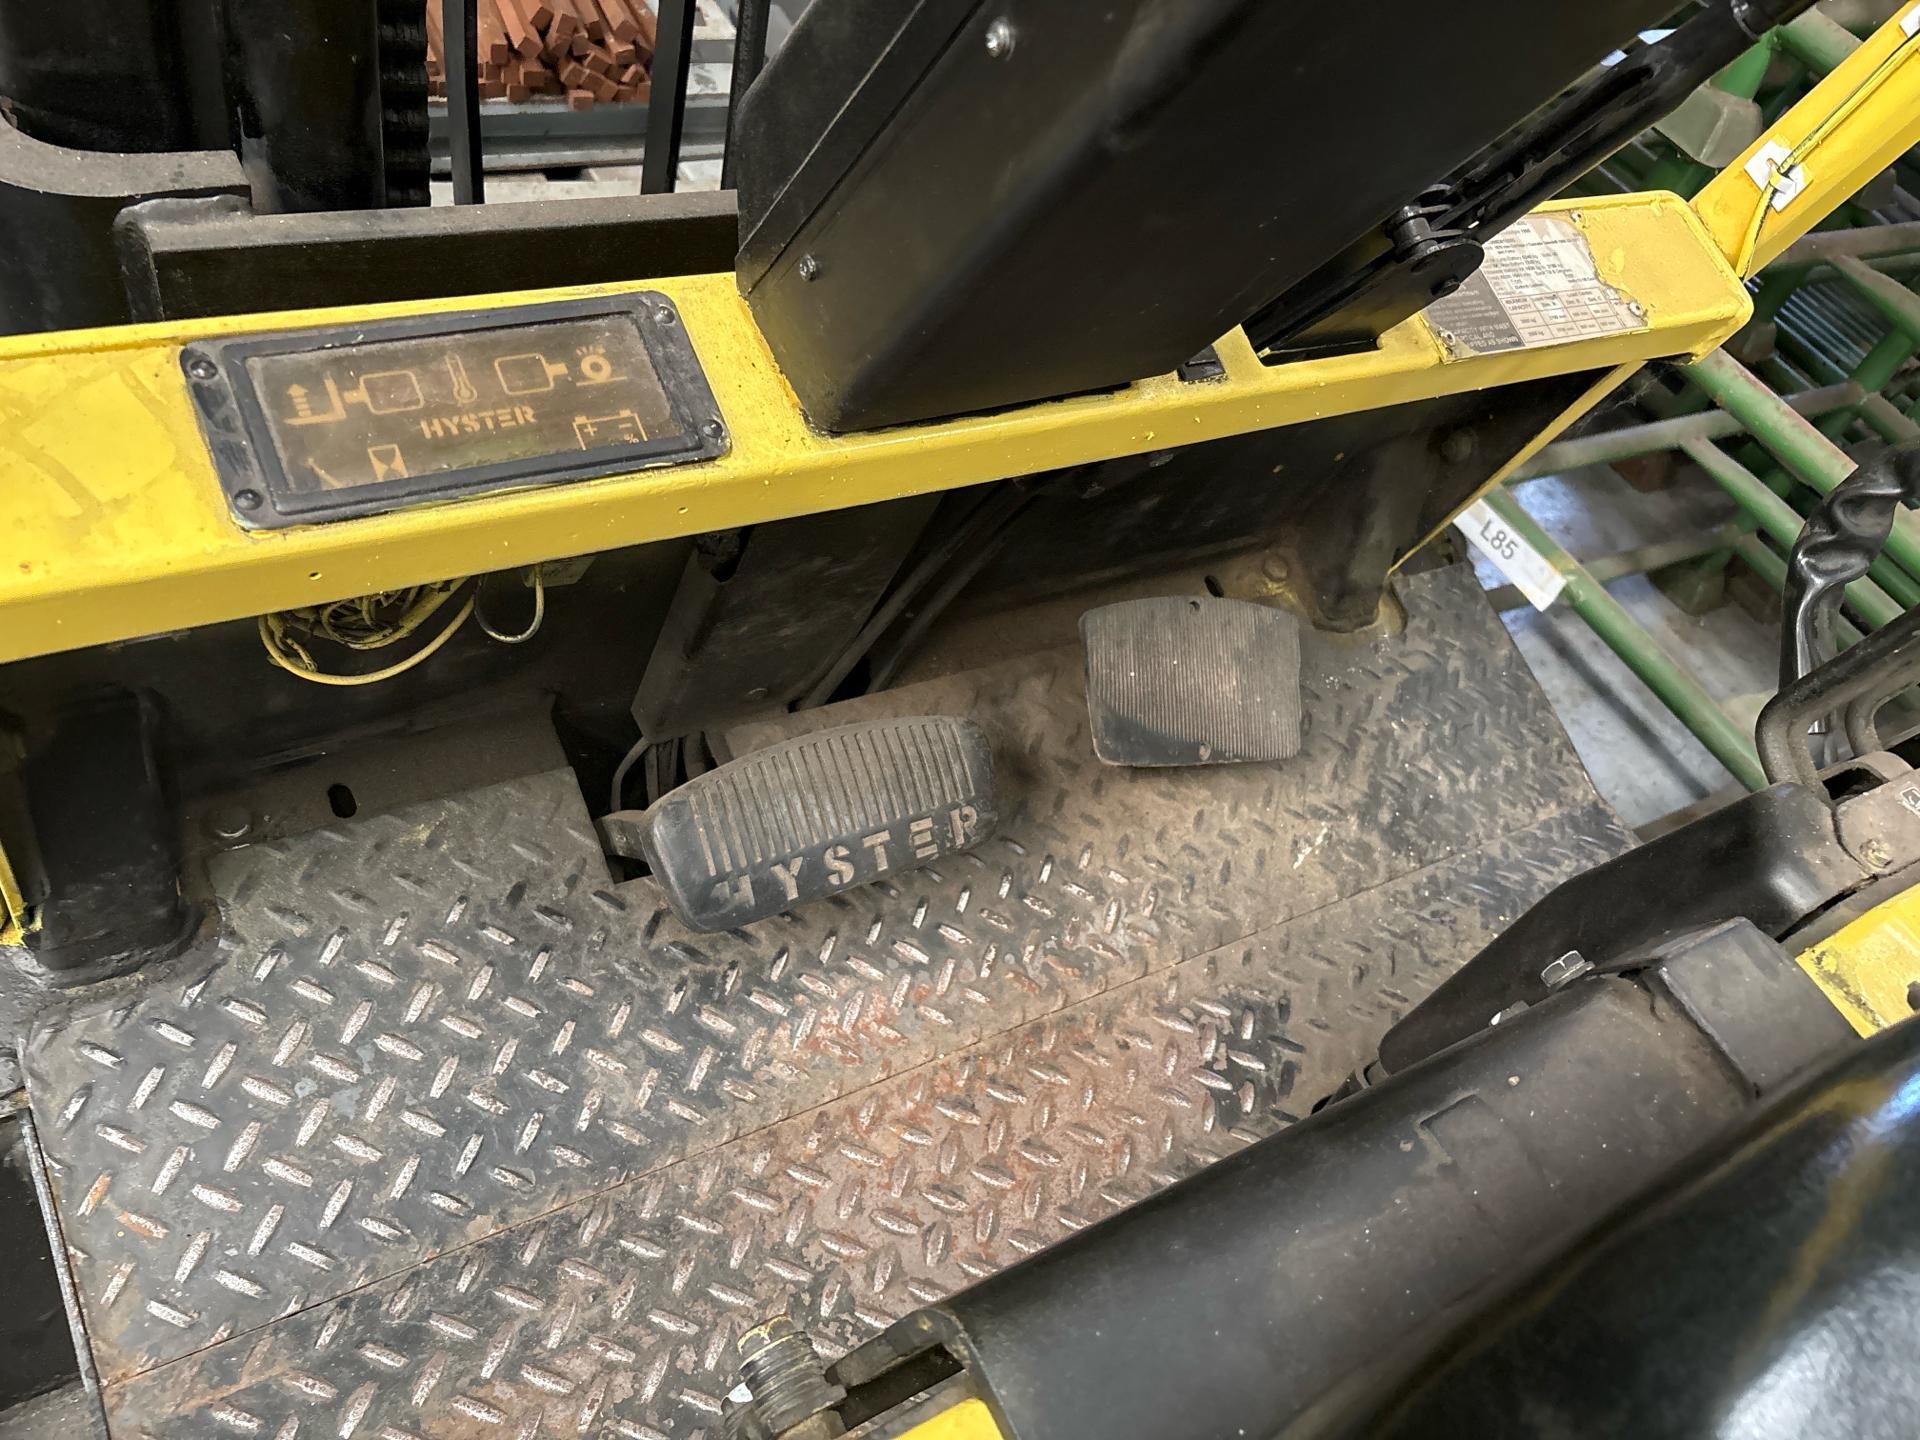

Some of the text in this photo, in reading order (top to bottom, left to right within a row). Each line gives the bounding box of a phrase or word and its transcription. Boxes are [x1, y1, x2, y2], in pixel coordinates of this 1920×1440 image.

[419, 405, 537, 439] HYSTER
[1480, 519, 1520, 560] L85
[708, 804, 978, 907] HYSTER
